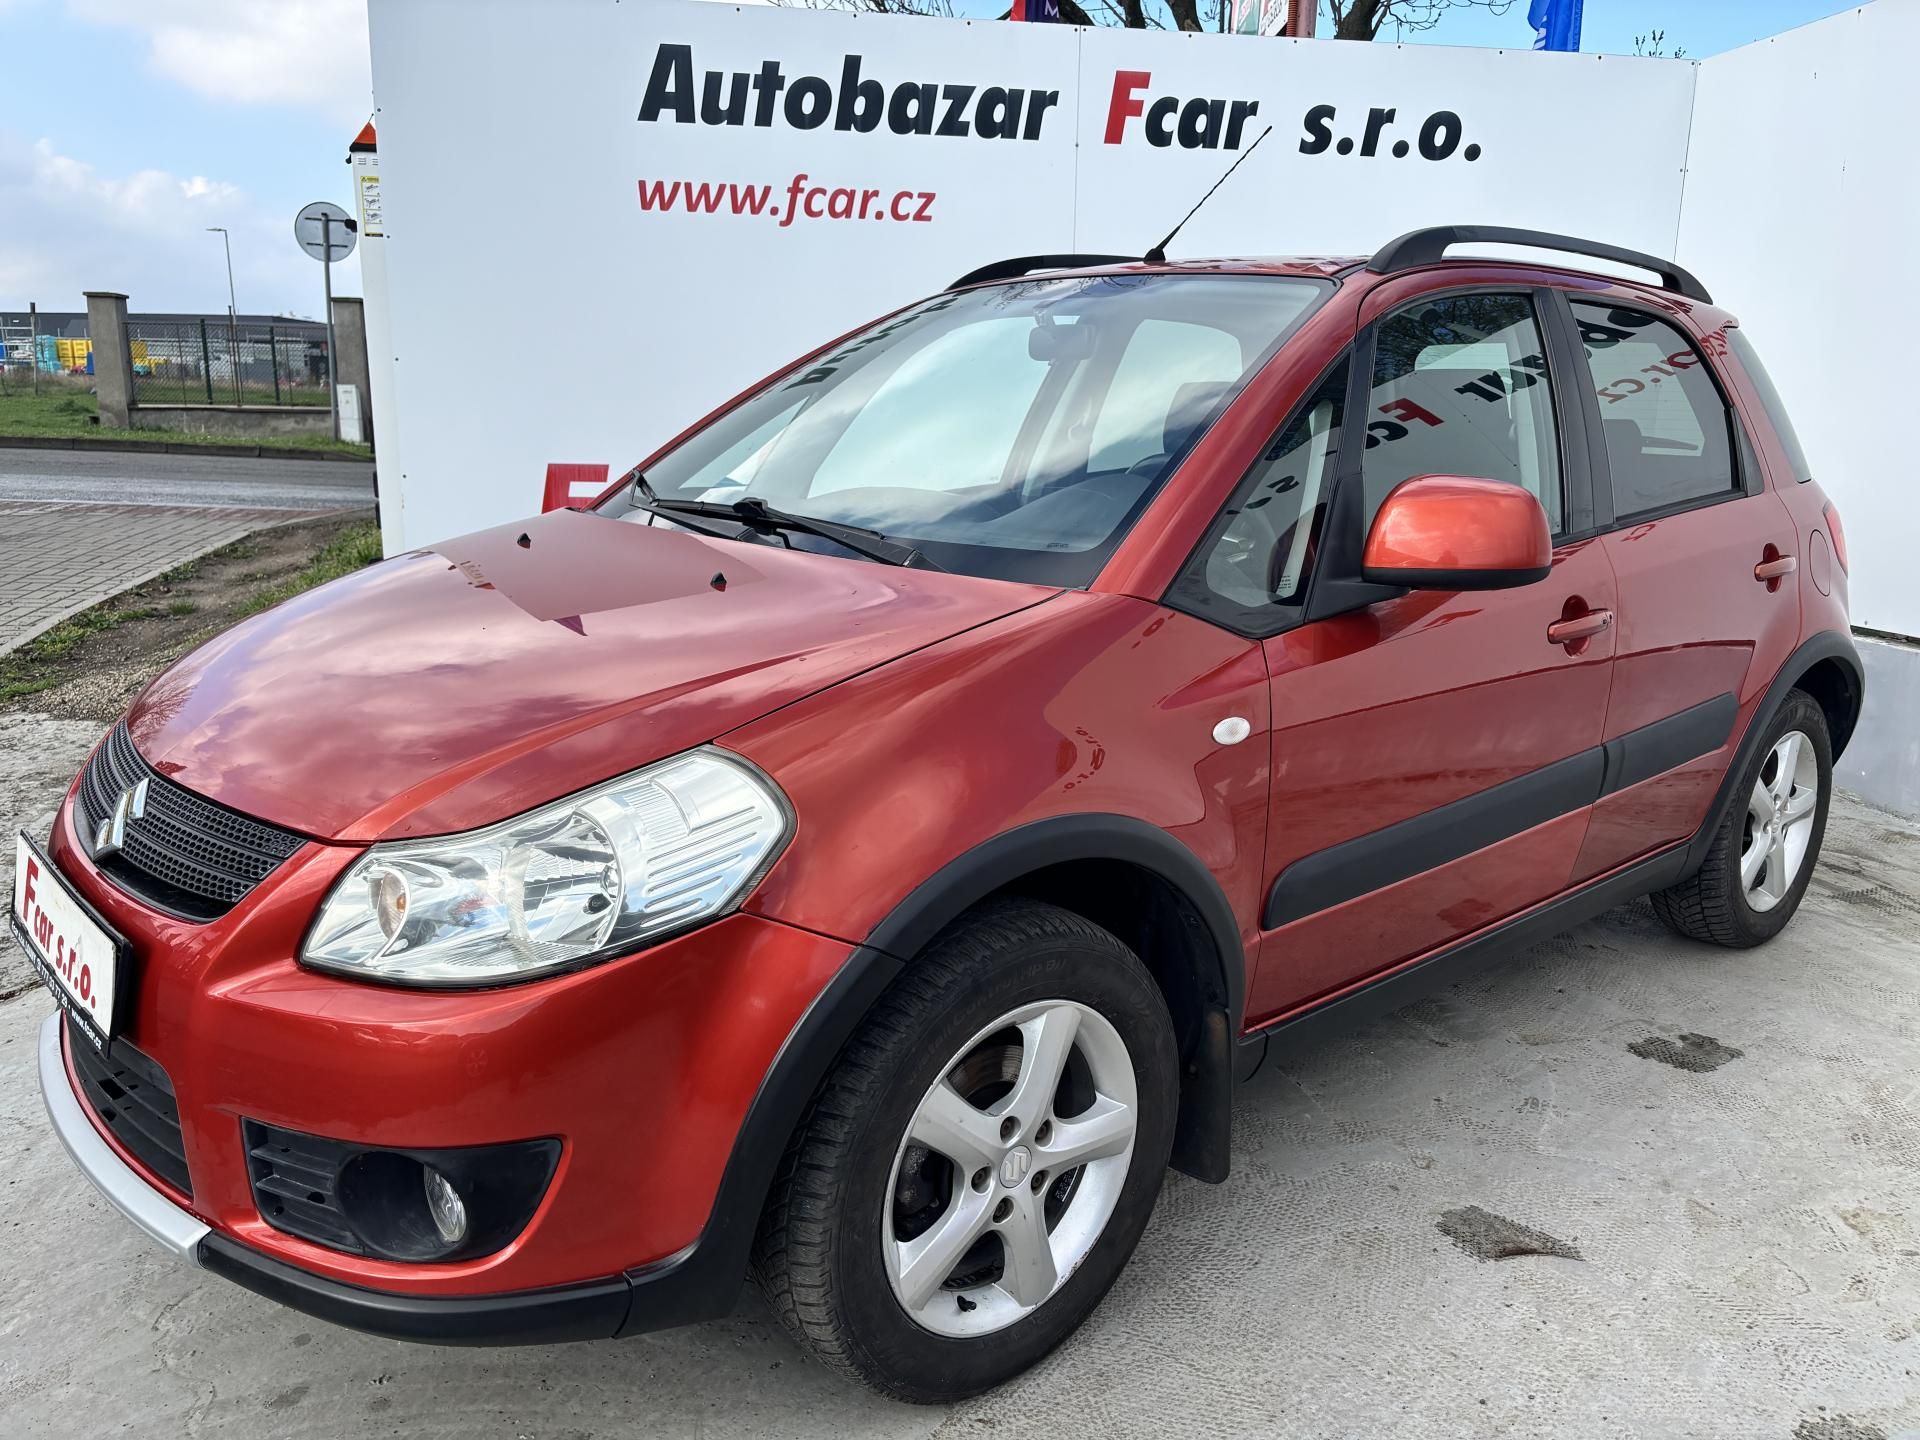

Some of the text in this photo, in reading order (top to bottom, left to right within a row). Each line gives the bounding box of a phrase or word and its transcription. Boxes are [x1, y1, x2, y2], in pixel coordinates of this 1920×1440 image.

[637, 43, 1482, 162] Autobazar Fcar s.r.o.
[637, 173, 937, 227] www.fcar.cz
[55, 935, 96, 1009] s.r.o.
